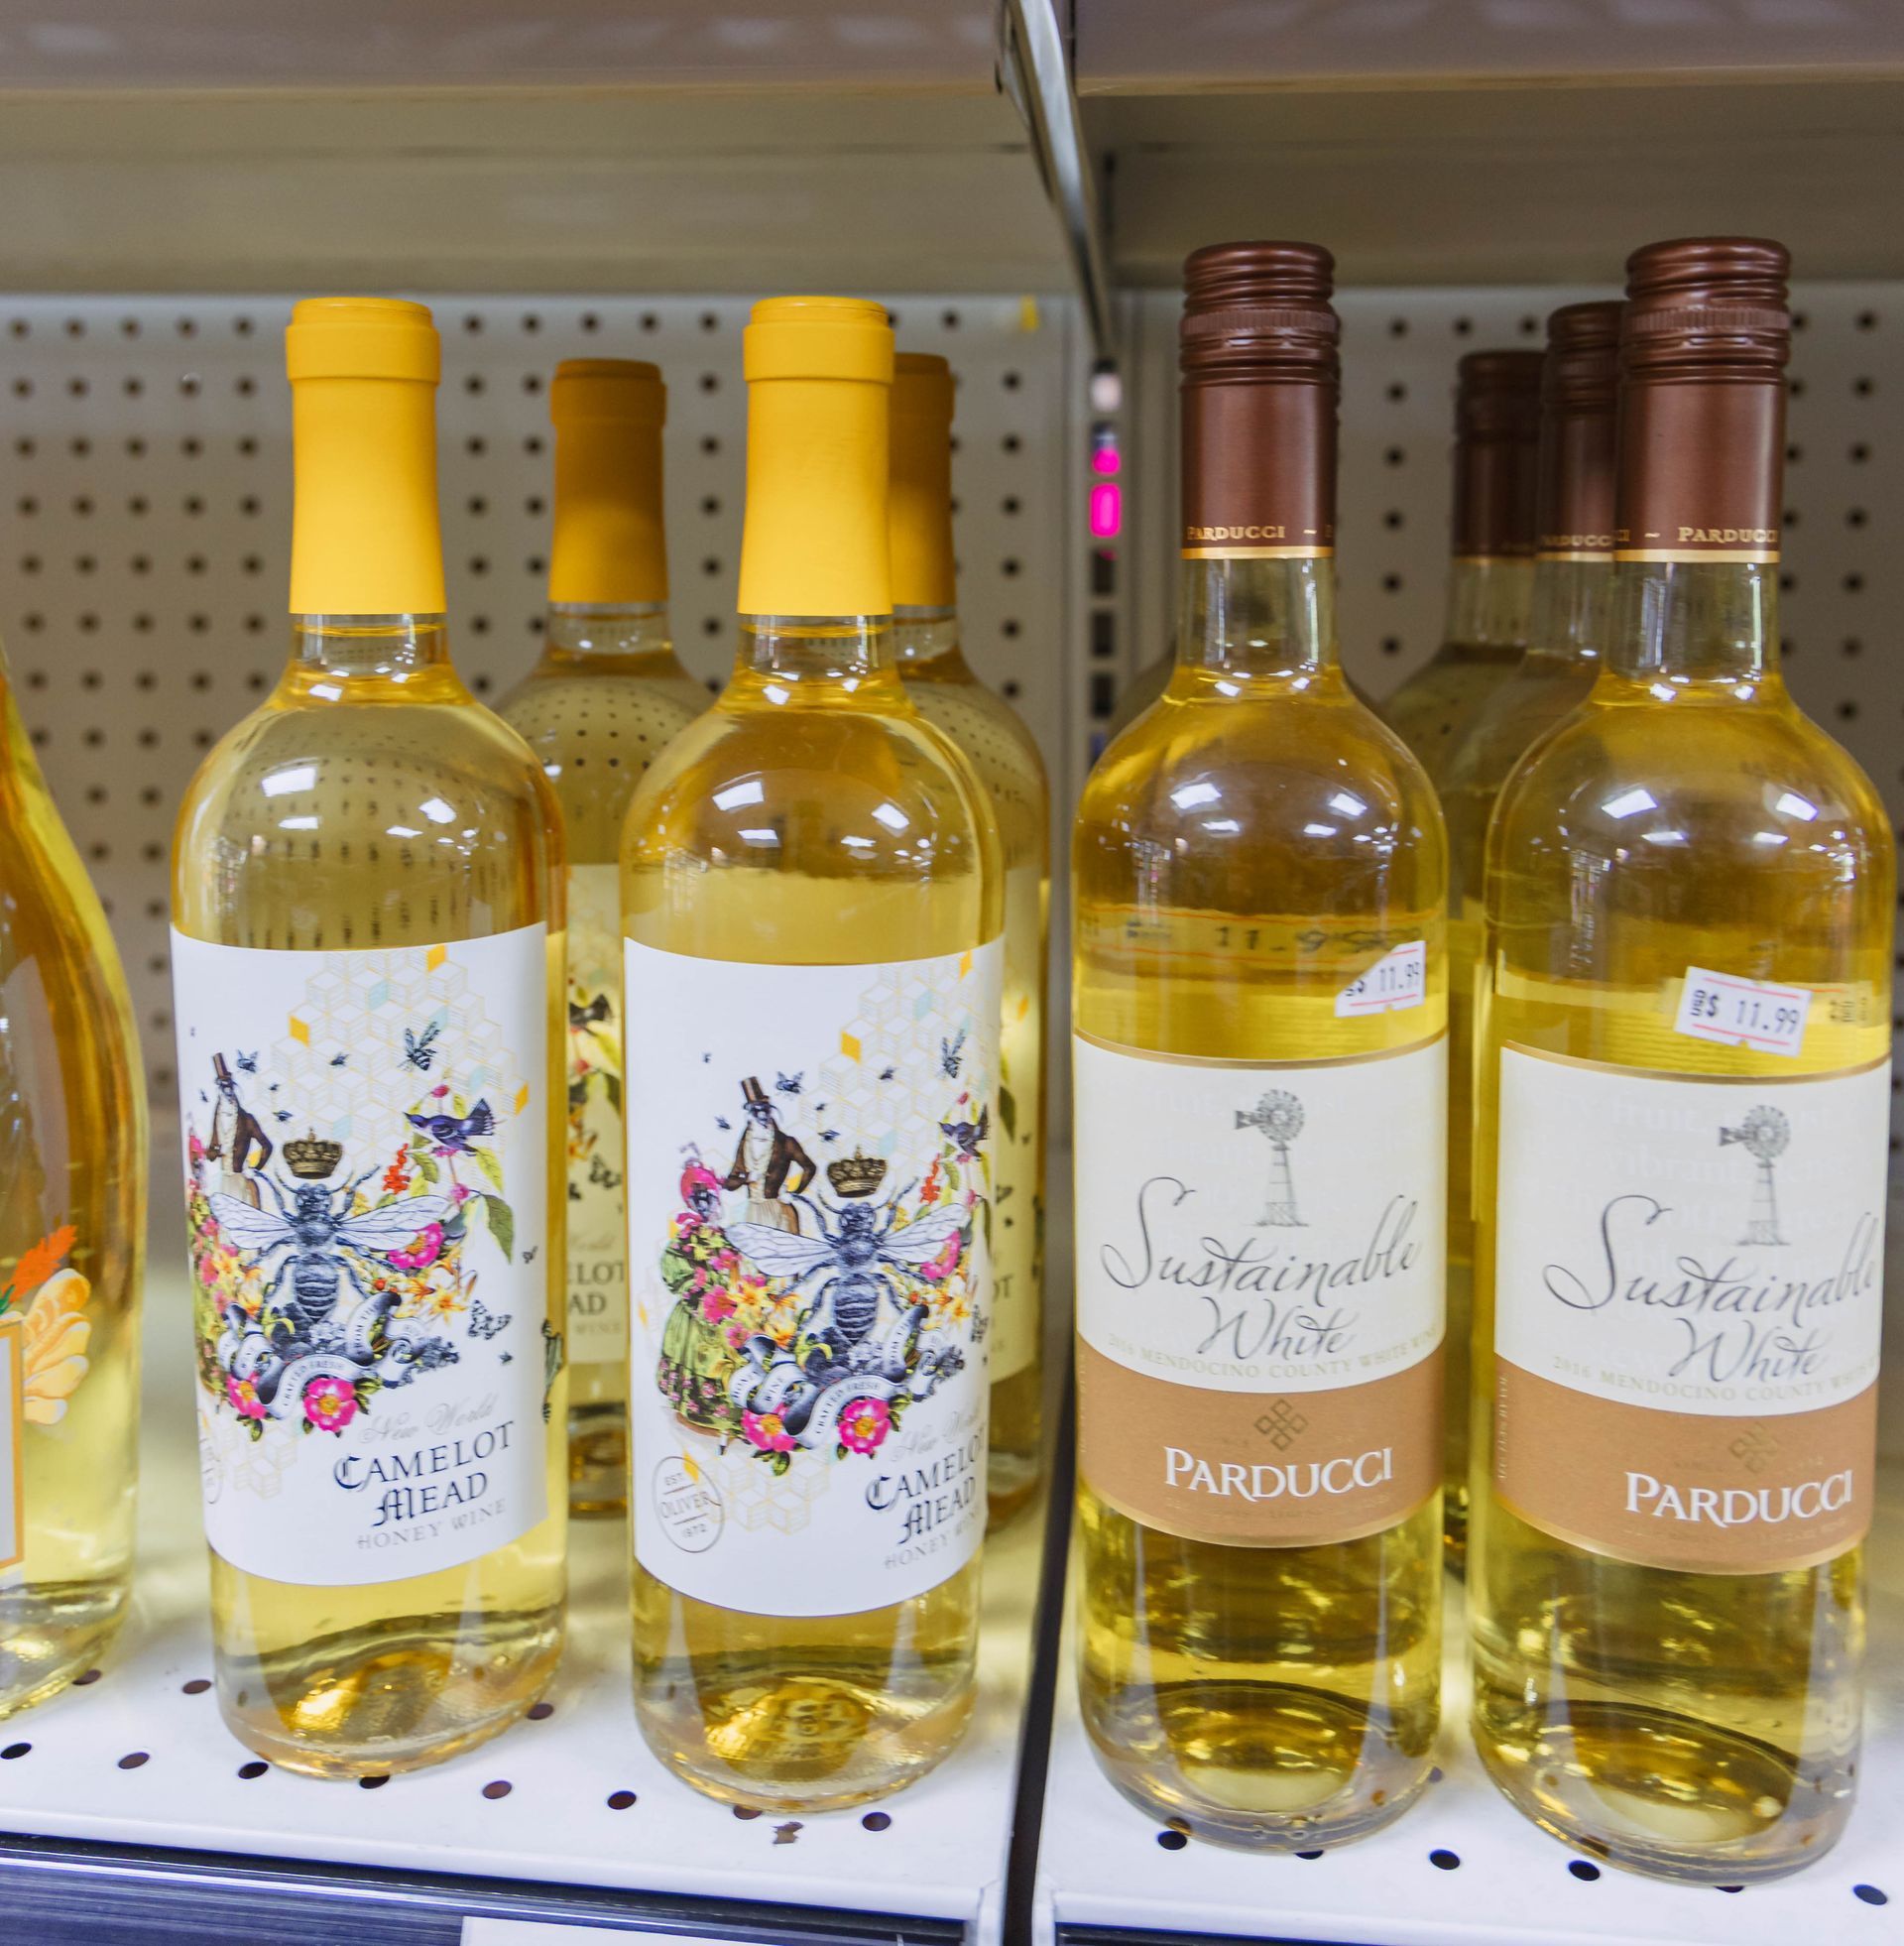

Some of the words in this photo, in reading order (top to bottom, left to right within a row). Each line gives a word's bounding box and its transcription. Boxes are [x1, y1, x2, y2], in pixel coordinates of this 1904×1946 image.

[1736, 999, 1801, 1035] 11.99
[1100, 1175, 1420, 1308] Sustainable
[1542, 1193, 1880, 1329] Sustainable
[1196, 1295, 1361, 1361] White
[1667, 1317, 1833, 1384] White
[1140, 1347, 1261, 1379] MENDOCINO
[1269, 1355, 1353, 1379] COUNTY
[1600, 1369, 1736, 1401] MENDOCINO
[1745, 1381, 1824, 1401] COUNTY
[332, 1419, 515, 1494] CAMELOT
[1163, 1445, 1393, 1504] PARDUCCI
[371, 1471, 488, 1527] MEAD
[896, 1476, 977, 1545] MEAD
[1623, 1468, 1853, 1529] PARDUCCI
[356, 1520, 443, 1550] HONEY
